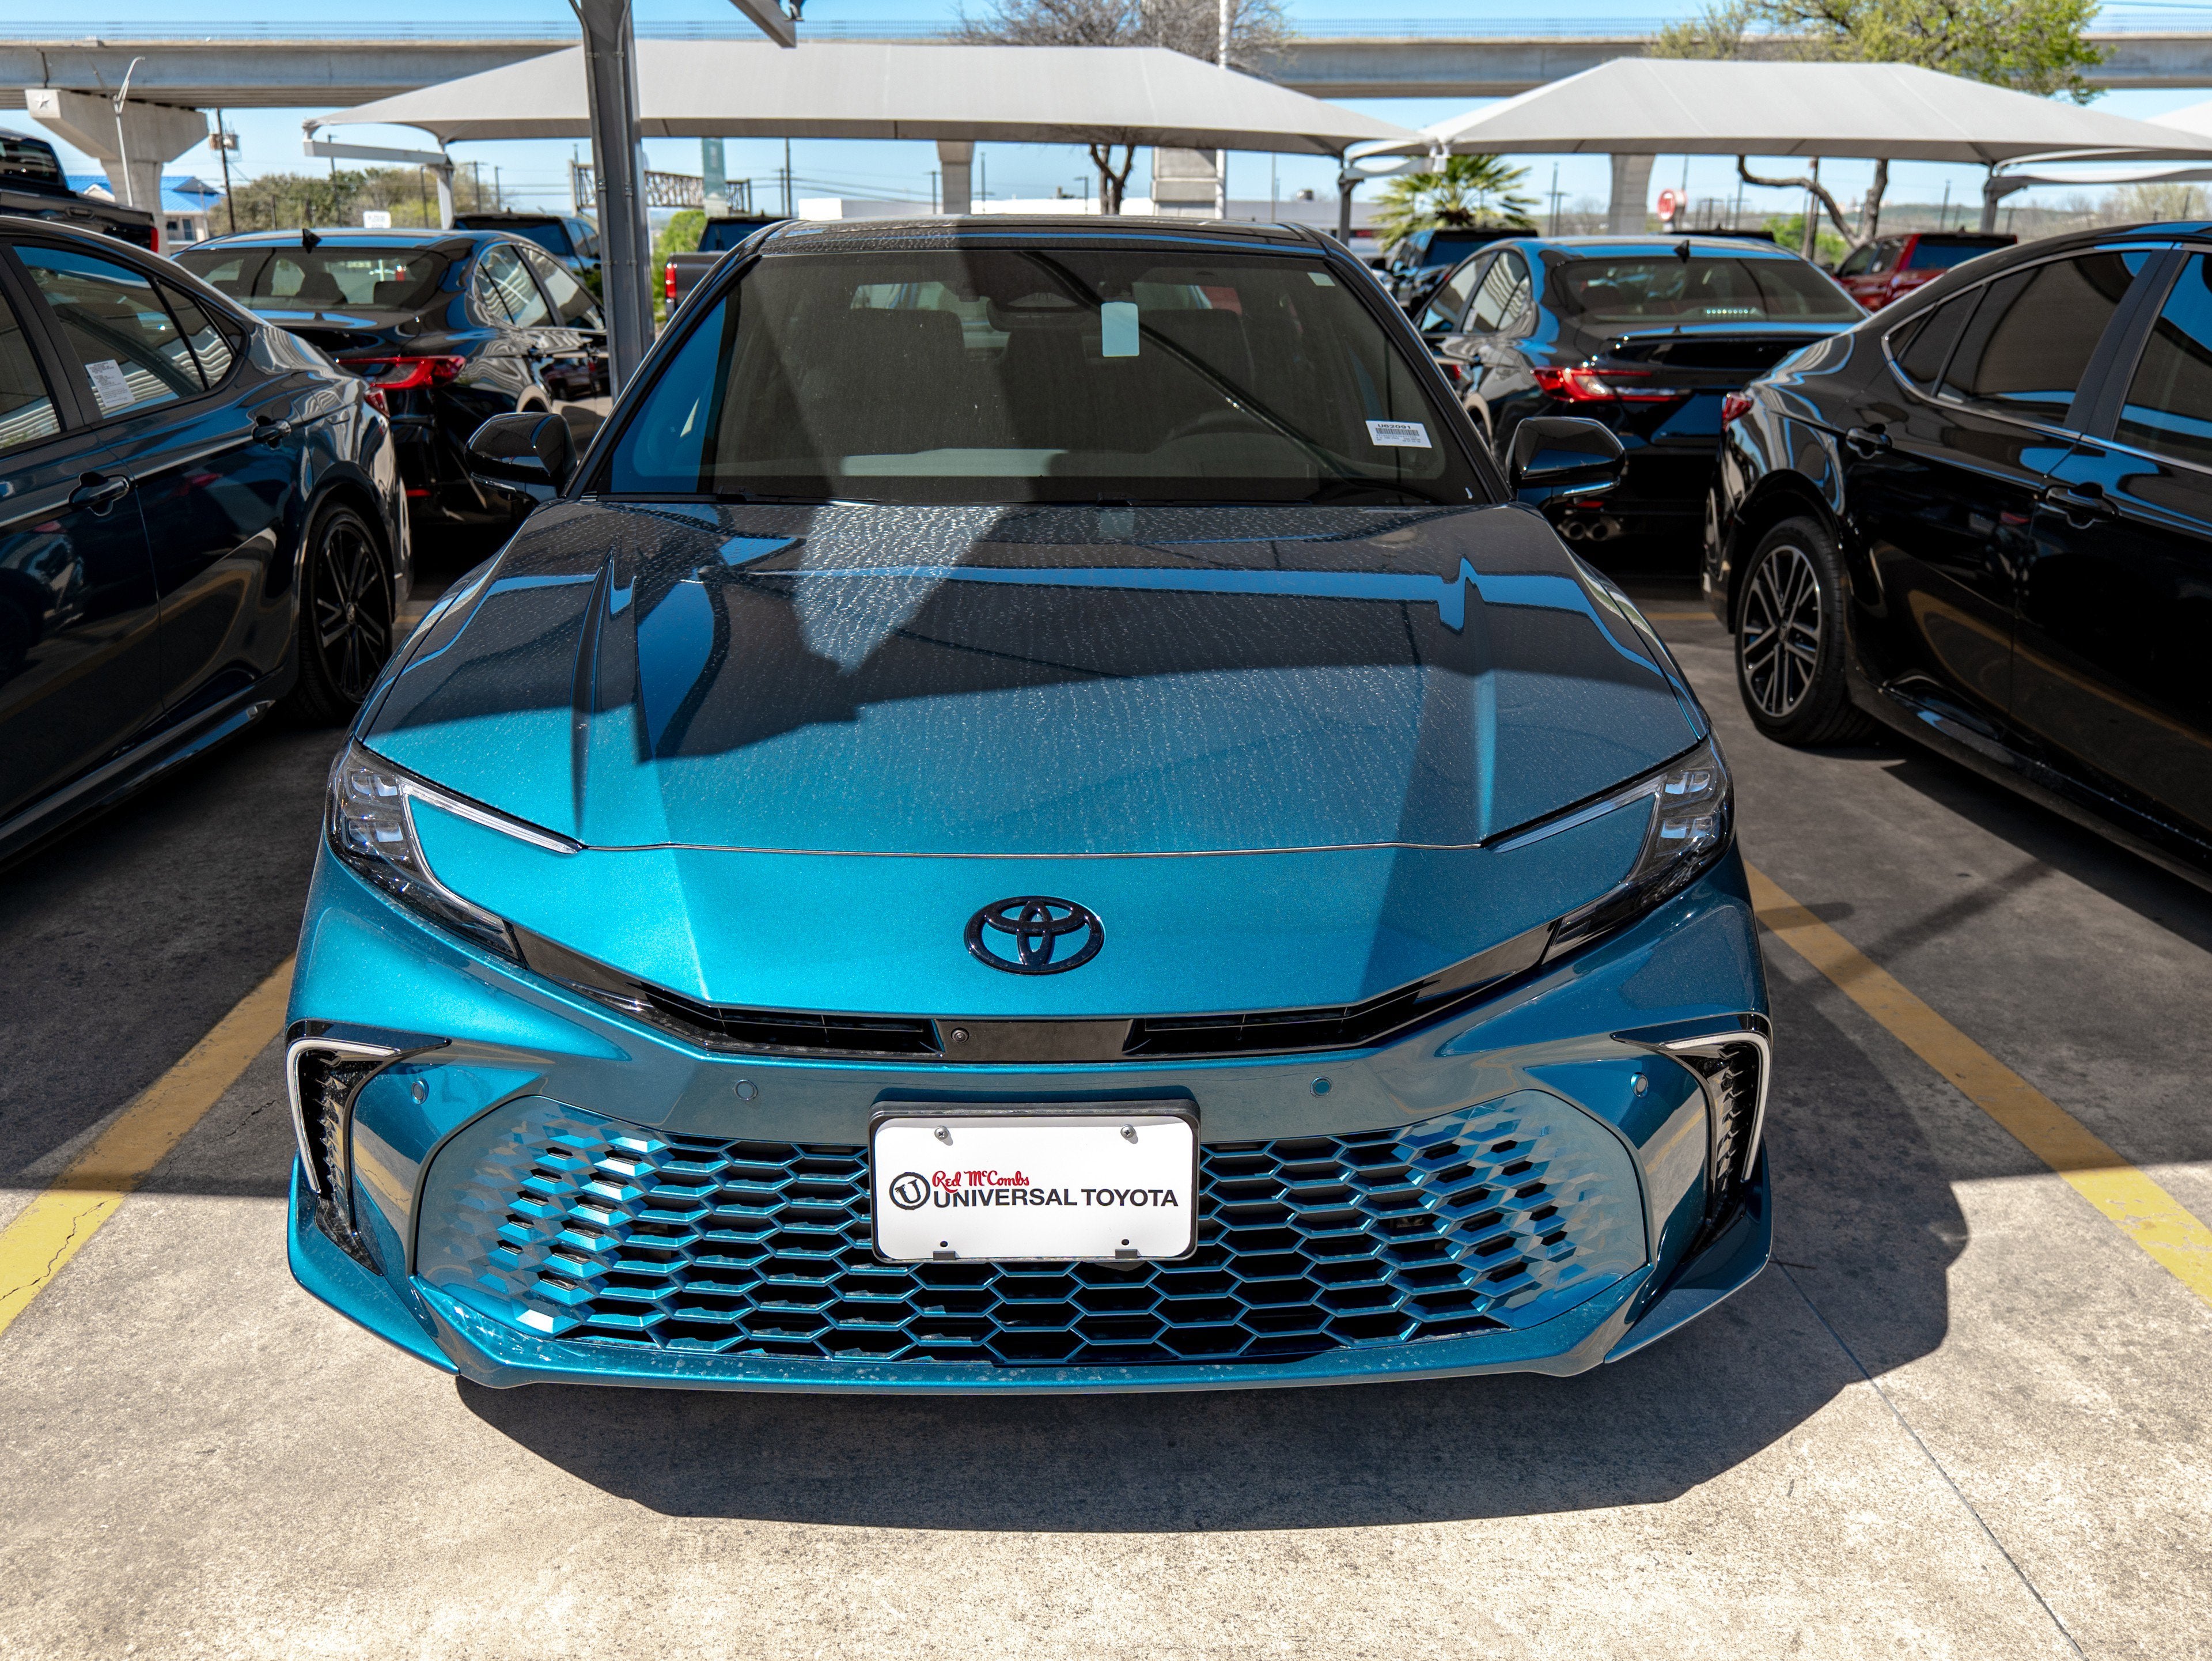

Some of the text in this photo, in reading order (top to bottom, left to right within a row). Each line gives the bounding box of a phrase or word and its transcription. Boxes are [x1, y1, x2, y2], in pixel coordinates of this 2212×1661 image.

[932, 1170, 1030, 1193] Red McCombs
[934, 1188, 1179, 1208] UNIVERSAL TOYOTA
